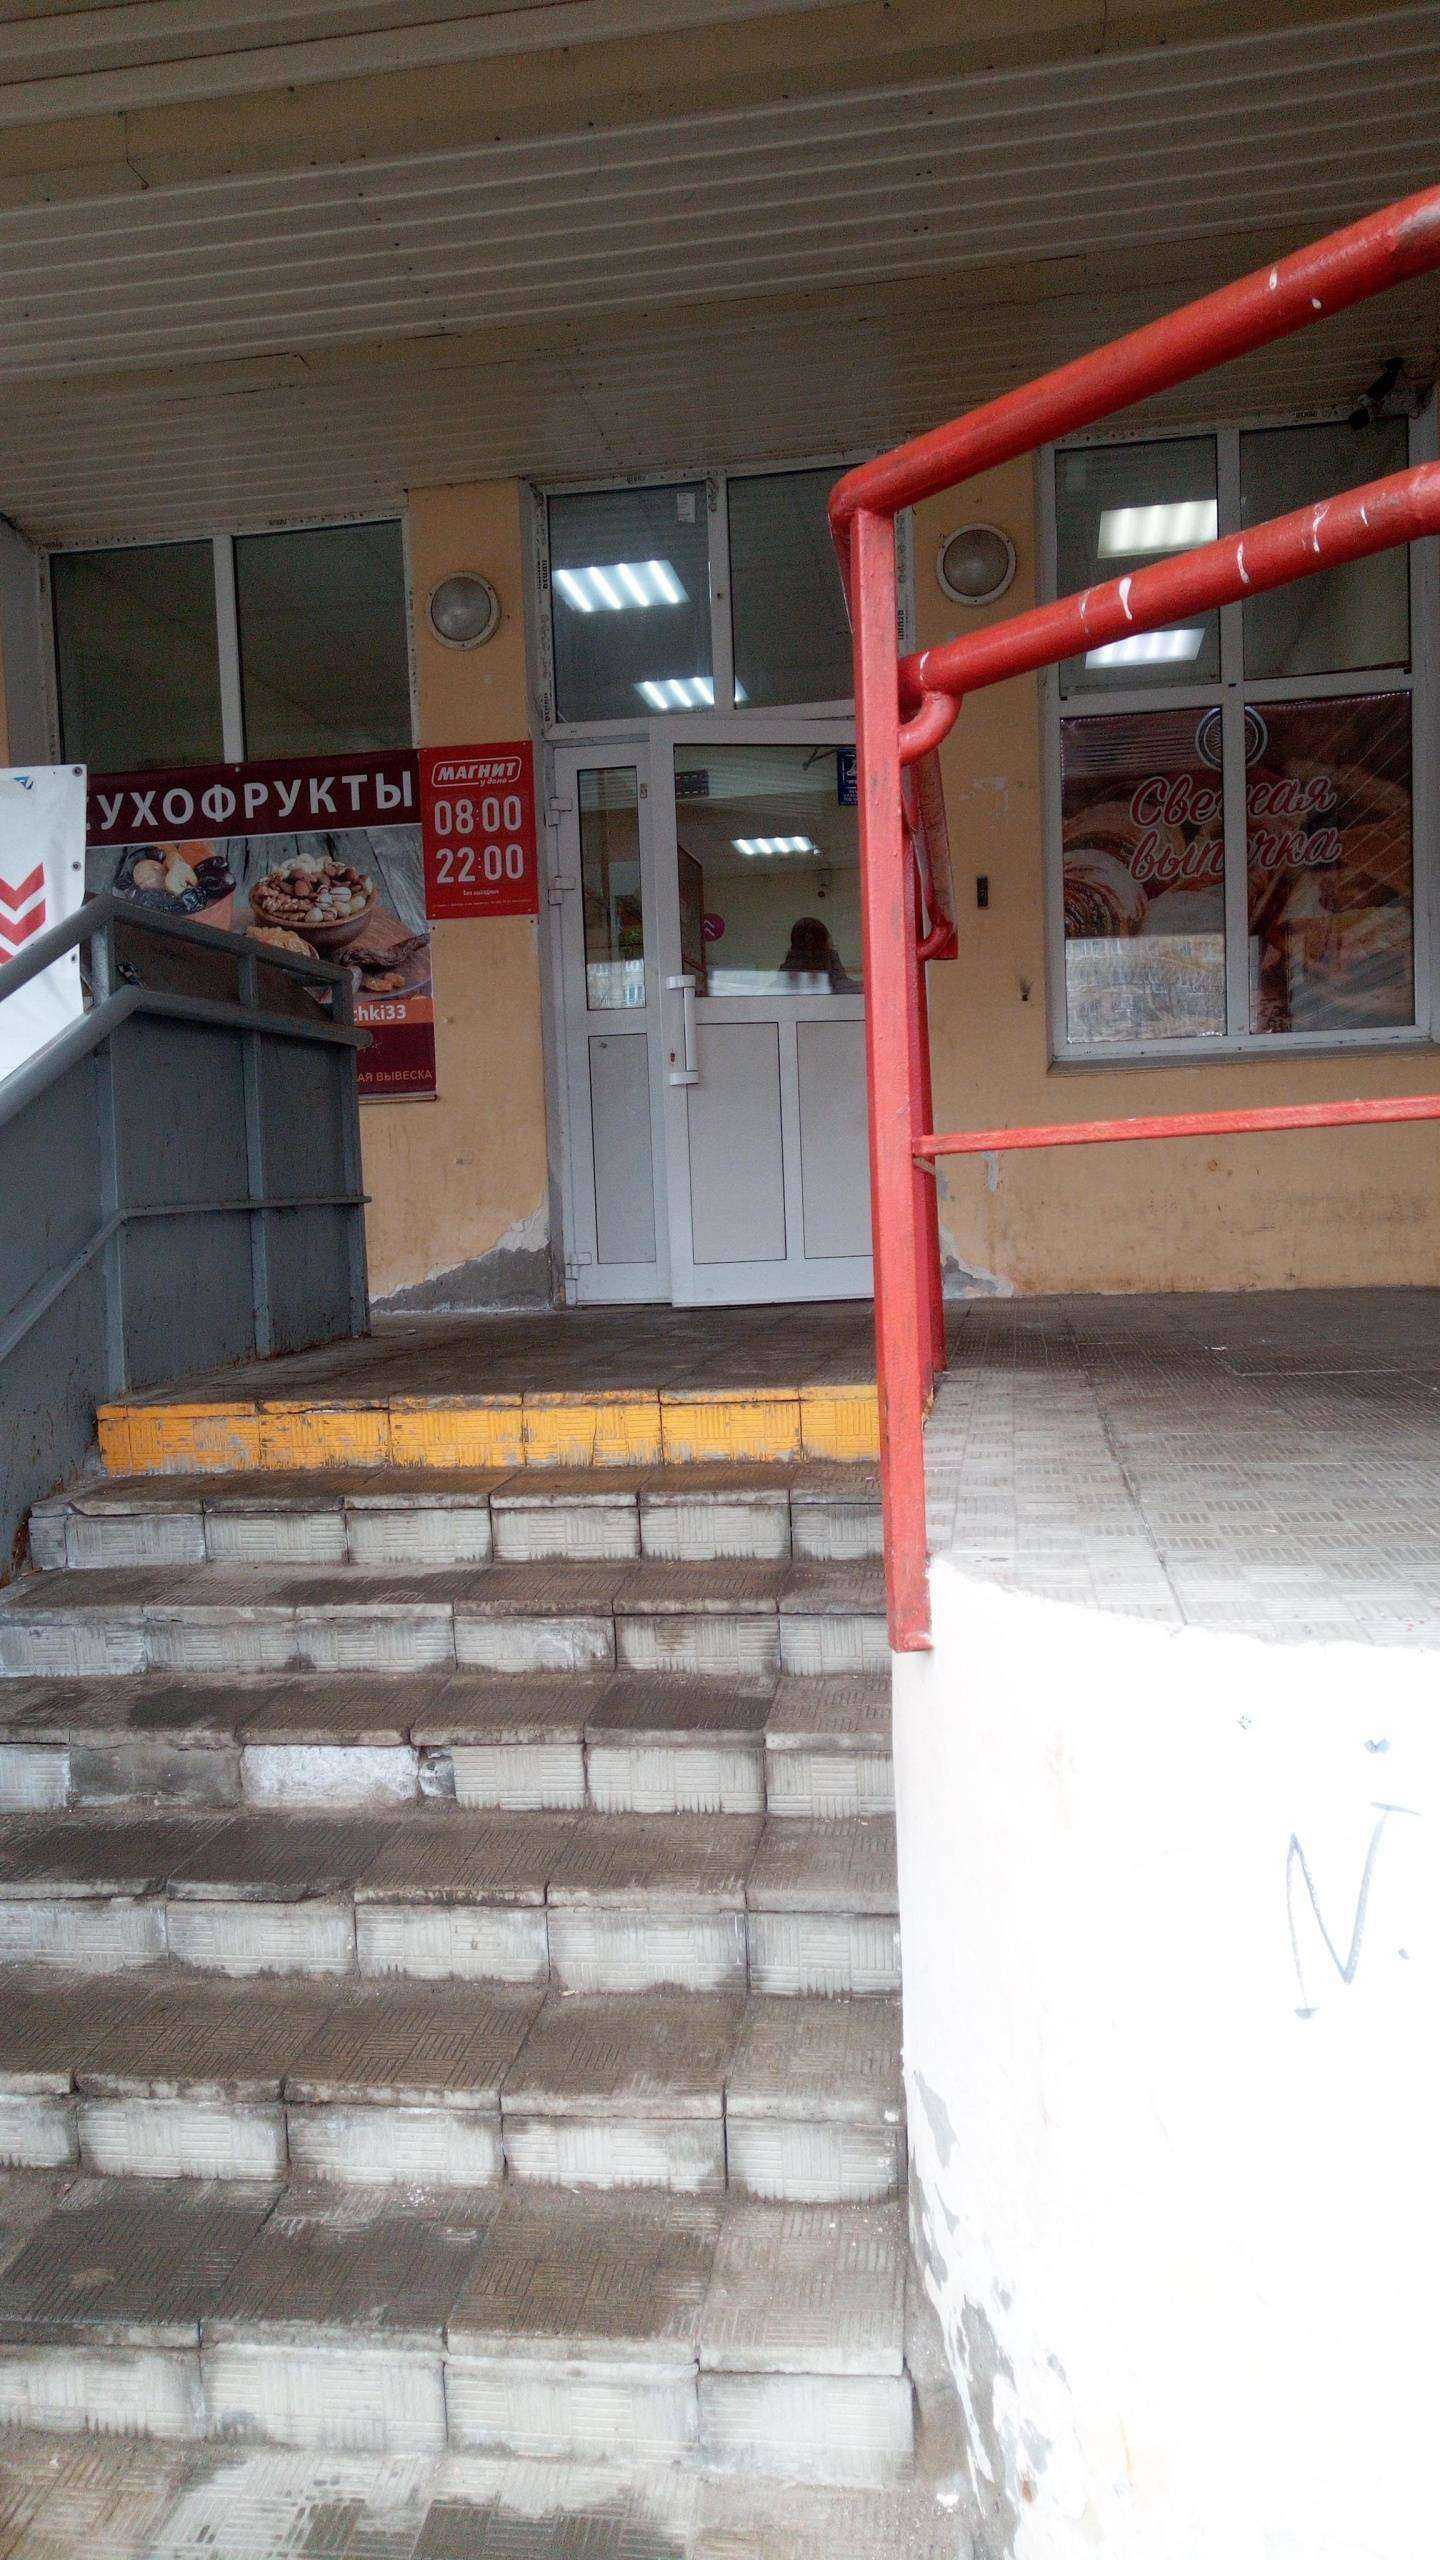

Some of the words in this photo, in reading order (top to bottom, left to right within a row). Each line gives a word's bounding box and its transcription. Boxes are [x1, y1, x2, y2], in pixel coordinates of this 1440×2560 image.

[437, 763, 516, 781] МАГНИТ
[86, 770, 413, 831] УХОФРУКТЫ
[434, 795, 522, 836] 08:00
[435, 843, 525, 884] 22:00
[1129, 827, 1342, 882] выпчка
[376, 1069, 433, 1082] ВЫВЕСКА
